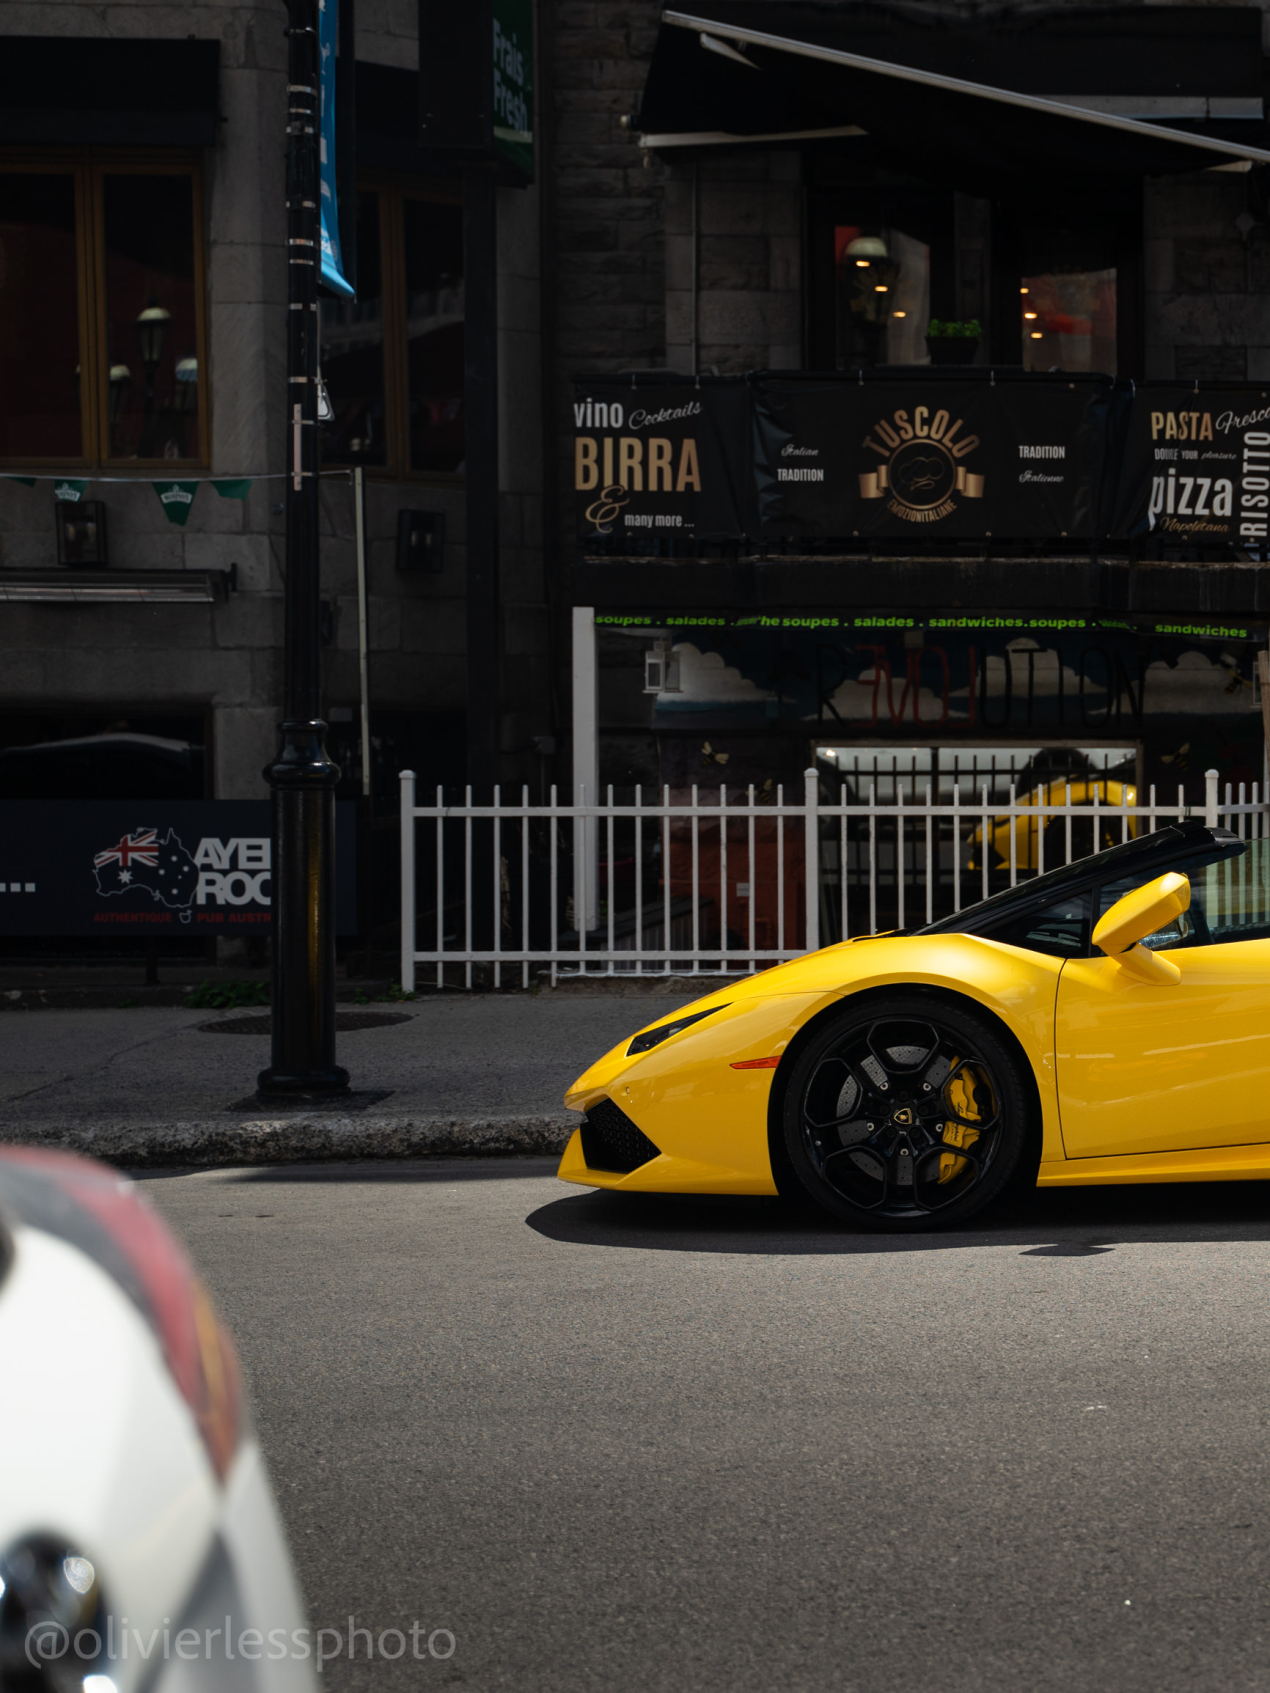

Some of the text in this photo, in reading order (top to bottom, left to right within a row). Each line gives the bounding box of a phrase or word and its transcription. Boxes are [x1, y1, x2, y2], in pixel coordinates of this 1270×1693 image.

[493, 17, 524, 87] Frais
[493, 68, 529, 138] Fresh
[573, 397, 703, 430] vino Cocktails
[861, 405, 980, 458] TUSCOLO
[1150, 411, 1213, 441] PASTA
[781, 444, 819, 457] Italian
[1018, 445, 1066, 459] TRADITION
[1181, 450, 1198, 460] YOUR
[1200, 451, 1237, 461] pleasure
[575, 437, 702, 492] BIRRA
[777, 468, 824, 482] TRADITION
[1018, 469, 1065, 483] Italienne
[1147, 467, 1233, 531] pizza
[624, 514, 653, 528] many
[655, 514, 682, 528] more
[1160, 517, 1231, 533] Napoletana
[595, 615, 651, 627] soupes
[666, 616, 726, 626] salades
[782, 616, 838, 628] soupes
[854, 616, 914, 628] salades
[1155, 623, 1247, 638] sandwiches
[196, 872, 271, 906] ROC
[93, 912, 271, 923] AUTHENTIQUE PUB AUSTR
